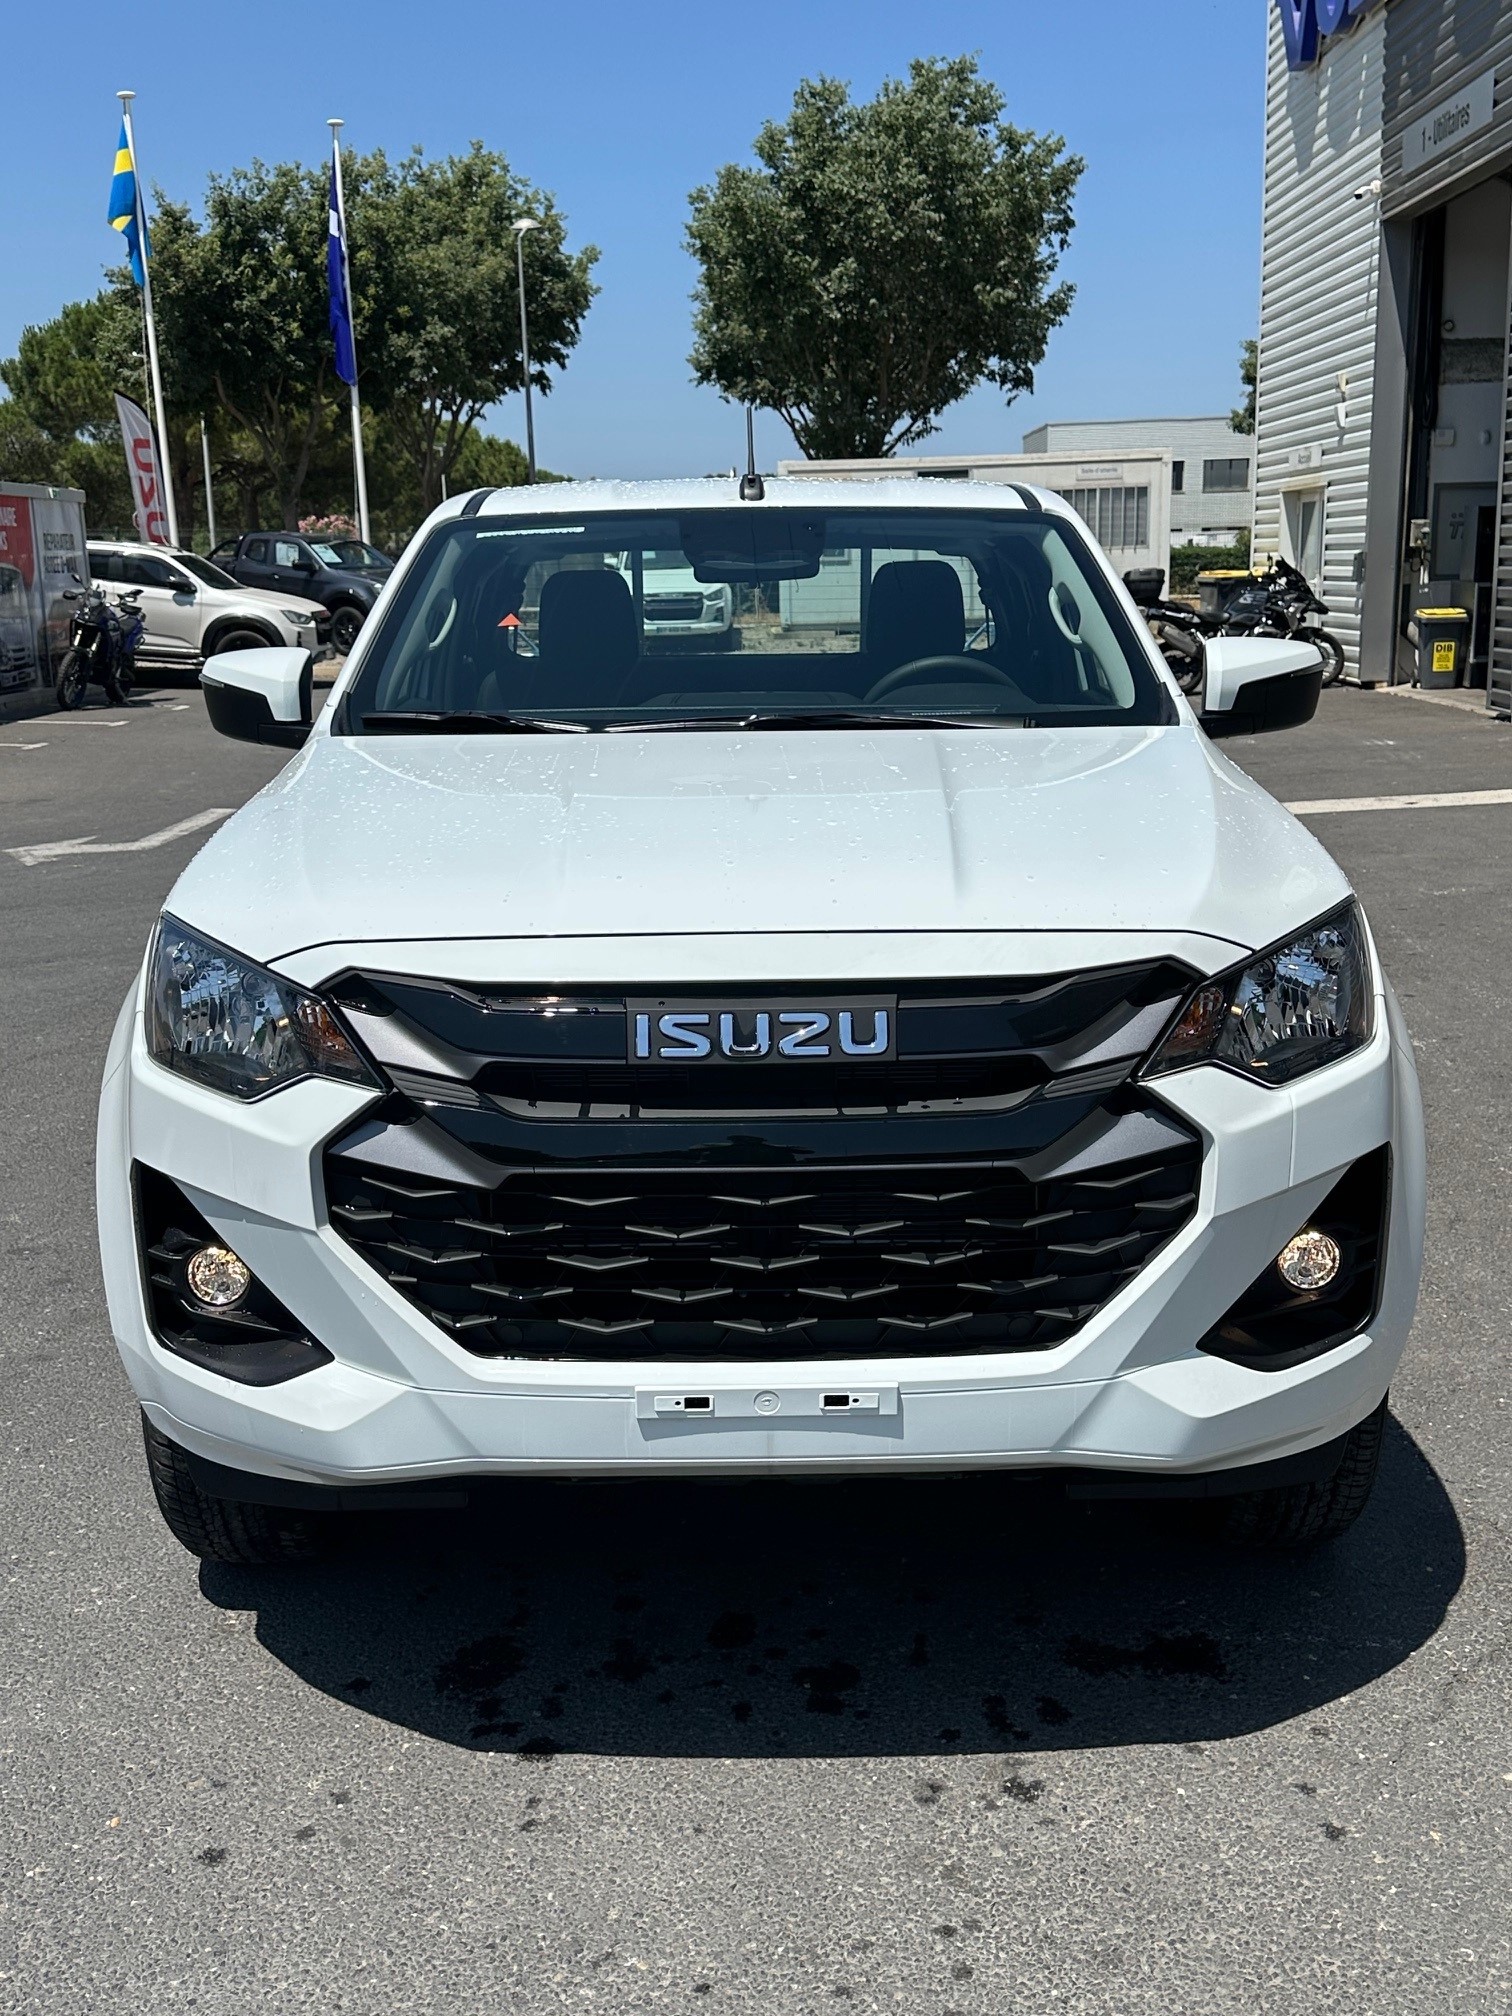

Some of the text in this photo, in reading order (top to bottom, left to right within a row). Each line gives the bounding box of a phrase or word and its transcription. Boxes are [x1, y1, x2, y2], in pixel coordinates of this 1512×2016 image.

[1432, 103, 1471, 146] Utilitaires
[1436, 643, 1453, 653] DIB
[635, 1010, 888, 1058] ISUZU
